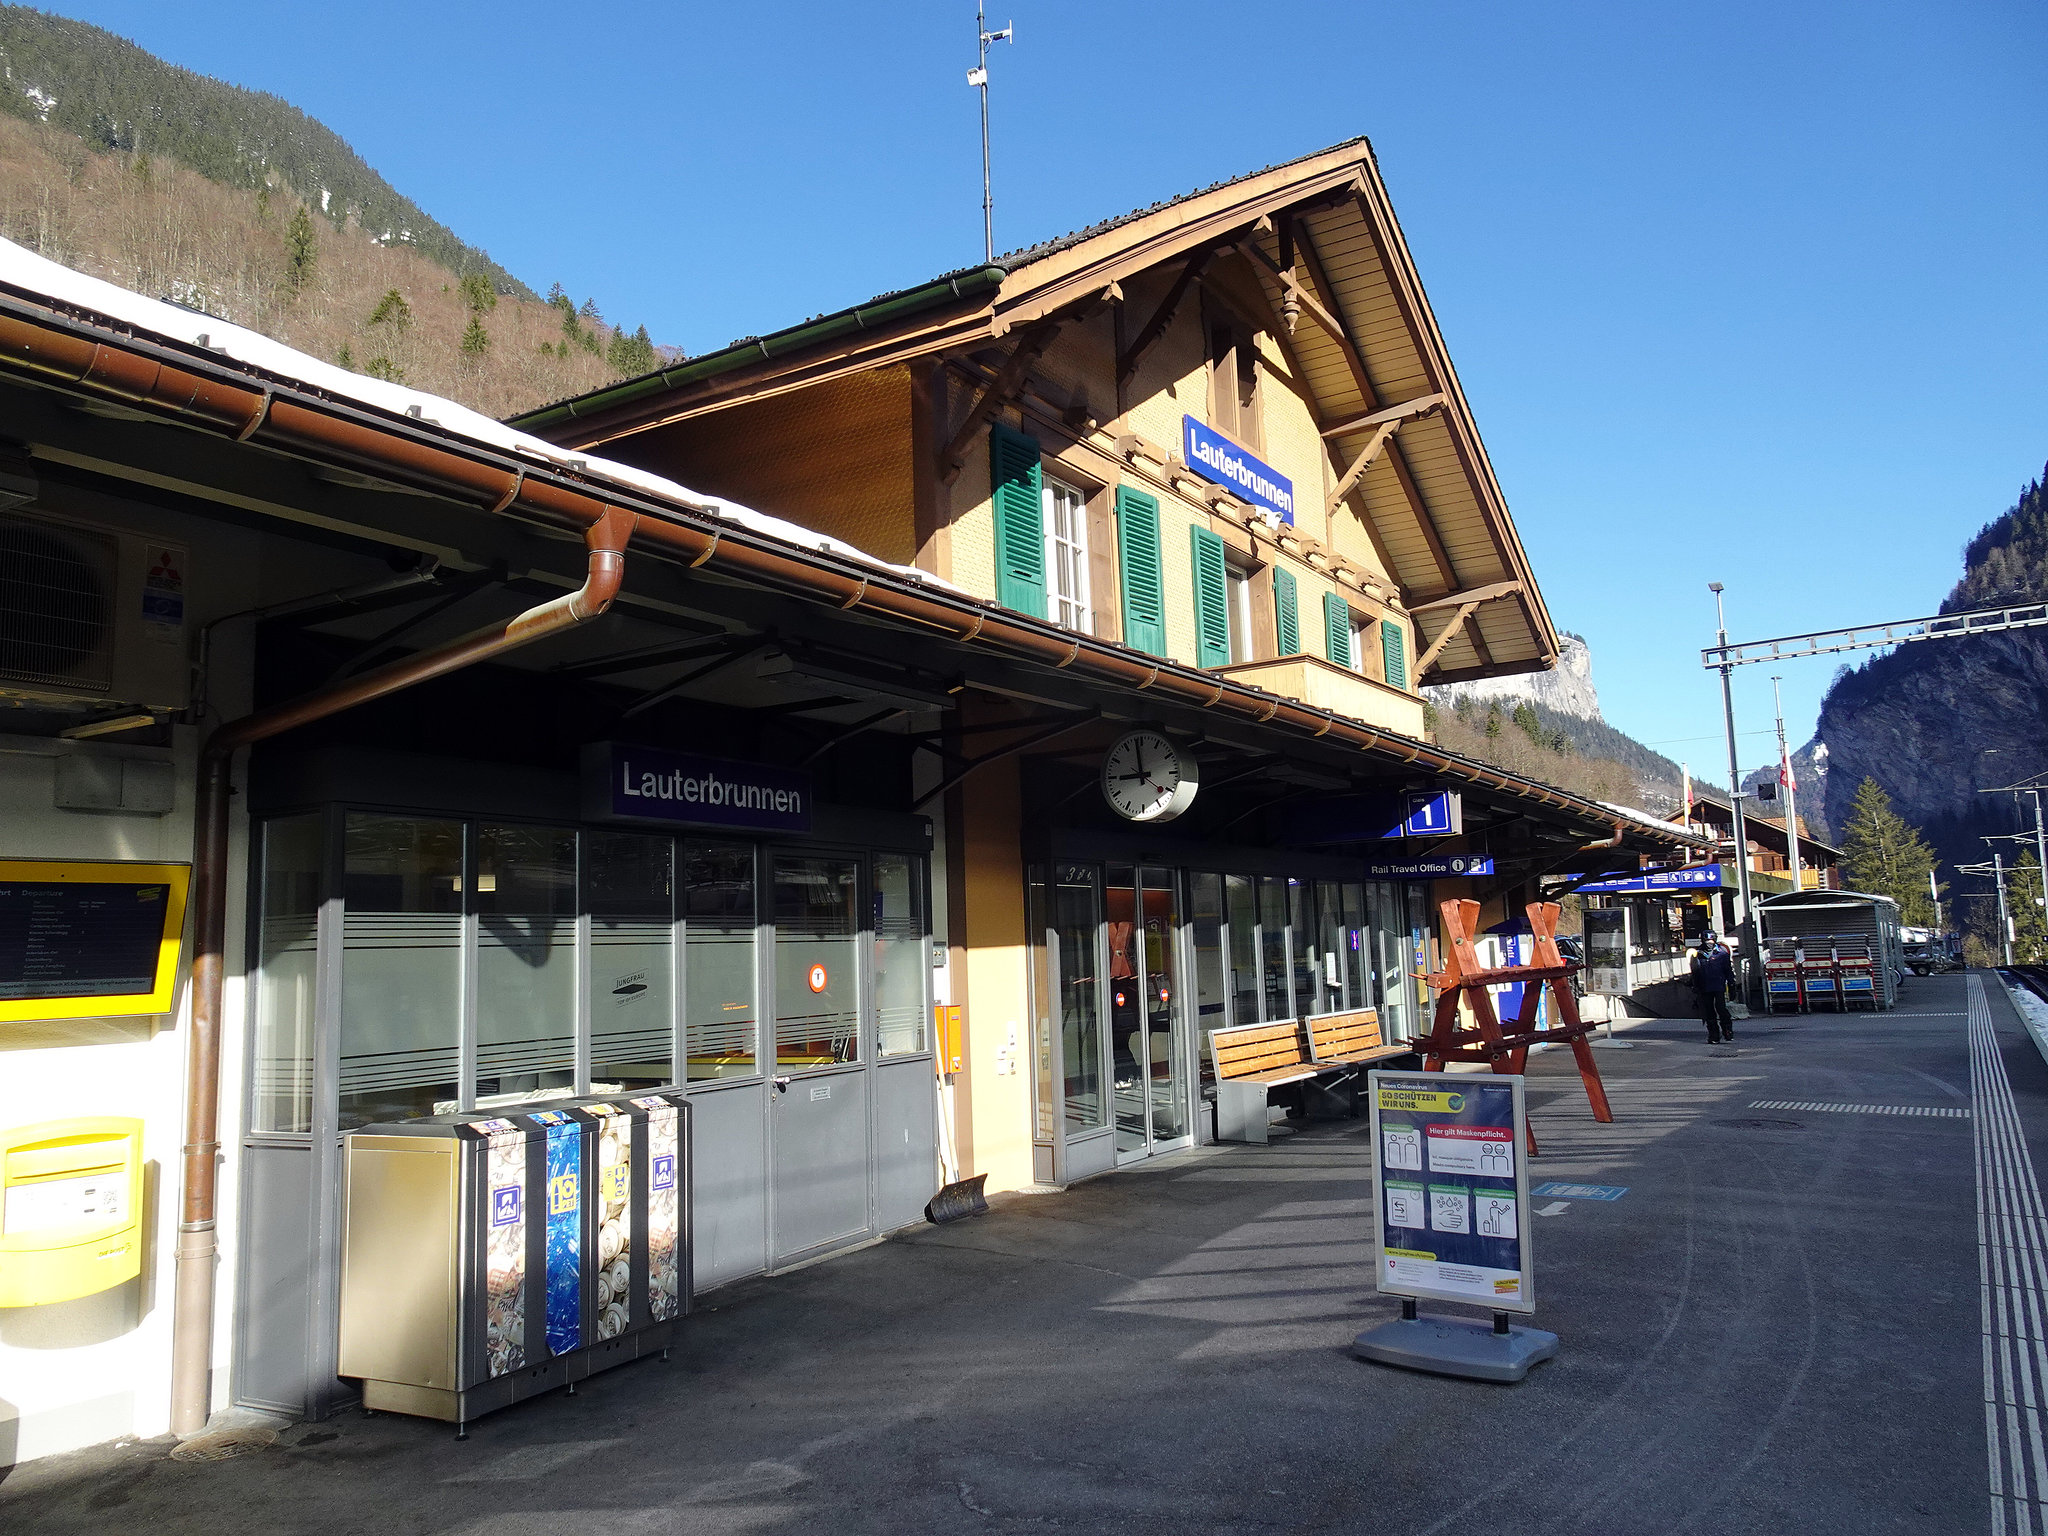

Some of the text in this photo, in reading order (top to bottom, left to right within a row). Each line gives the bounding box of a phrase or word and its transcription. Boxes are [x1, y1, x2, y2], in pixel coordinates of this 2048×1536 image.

[1190, 427, 1292, 514] Lauterbrunnen
[623, 760, 801, 814] Lauterbrunnen
[1421, 803, 1432, 826] 1
[1371, 863, 1447, 874] Rail Travel Office
[616, 972, 645, 988] JUNGFRAU
[1381, 1091, 1437, 1102] SO SCHÜTZEN
[1382, 1099, 1419, 1109] WIR UNS.
[1429, 1127, 1506, 1139] Hier gilt Maskenpflicht.
